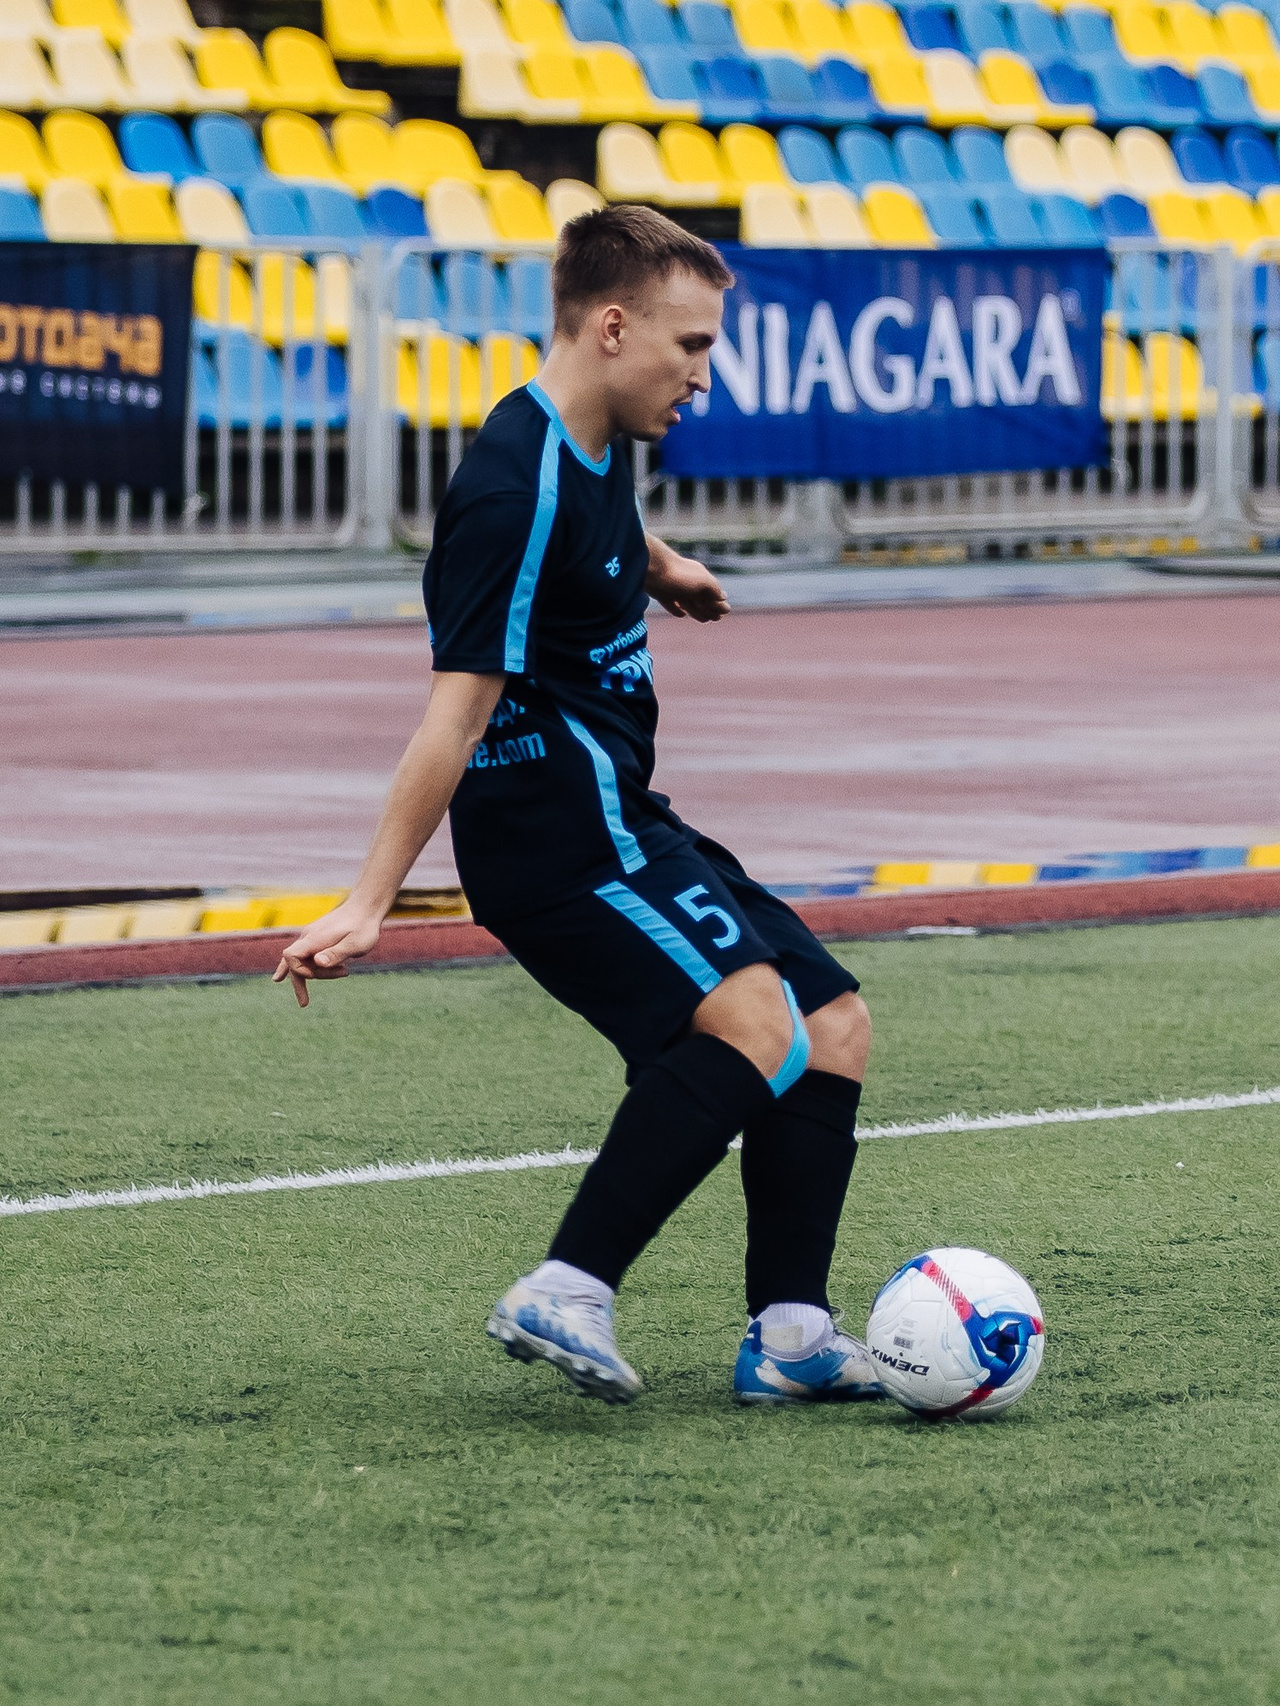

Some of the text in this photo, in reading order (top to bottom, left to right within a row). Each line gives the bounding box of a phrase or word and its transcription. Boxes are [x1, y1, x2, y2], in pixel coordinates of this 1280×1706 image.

[692, 294, 1082, 415] NIAGARA
[467, 732, 546, 769] e.com
[673, 884, 740, 949] 5
[871, 1345, 930, 1376] DEMIX
